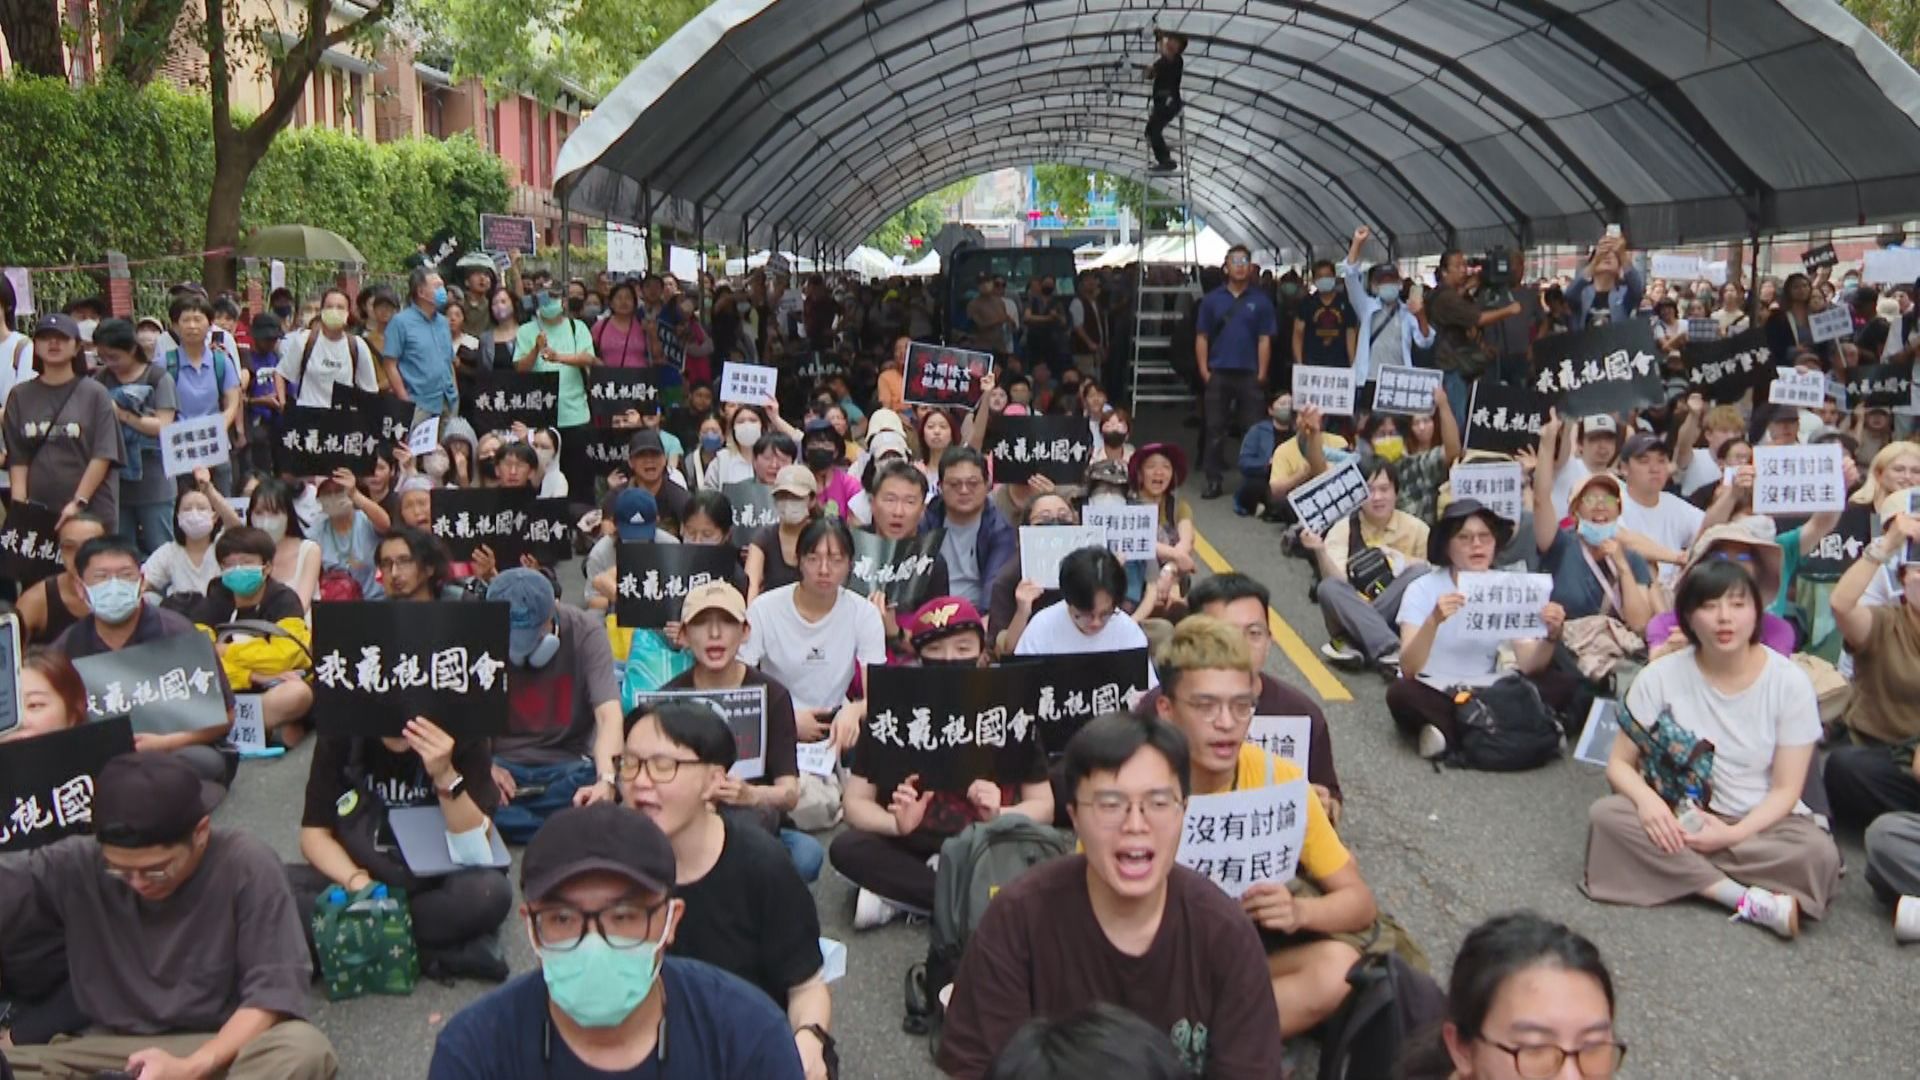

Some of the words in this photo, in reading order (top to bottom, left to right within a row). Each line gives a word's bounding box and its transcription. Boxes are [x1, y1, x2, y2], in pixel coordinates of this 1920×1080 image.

[1297, 373, 1349, 389] 沒有討論
[1535, 349, 1655, 394] 我藐視國會
[475, 389, 557, 412] 我藐視國會
[282, 429, 379, 456] 我藐視國會
[993, 437, 1088, 463] 我藐視國會
[1762, 456, 1834, 476] 沒有討論
[1457, 477, 1516, 494] 沒有討論
[1762, 483, 1836, 503] 沒有民主
[432, 509, 528, 539] 我藐視國會
[1089, 514, 1151, 530] 沒有討論
[1466, 612, 1540, 630] 沒有民主
[315, 645, 505, 693] 我藐視國會
[869, 706, 1035, 750] 我藐視國會
[1187, 801, 1297, 844] 沒有討論
